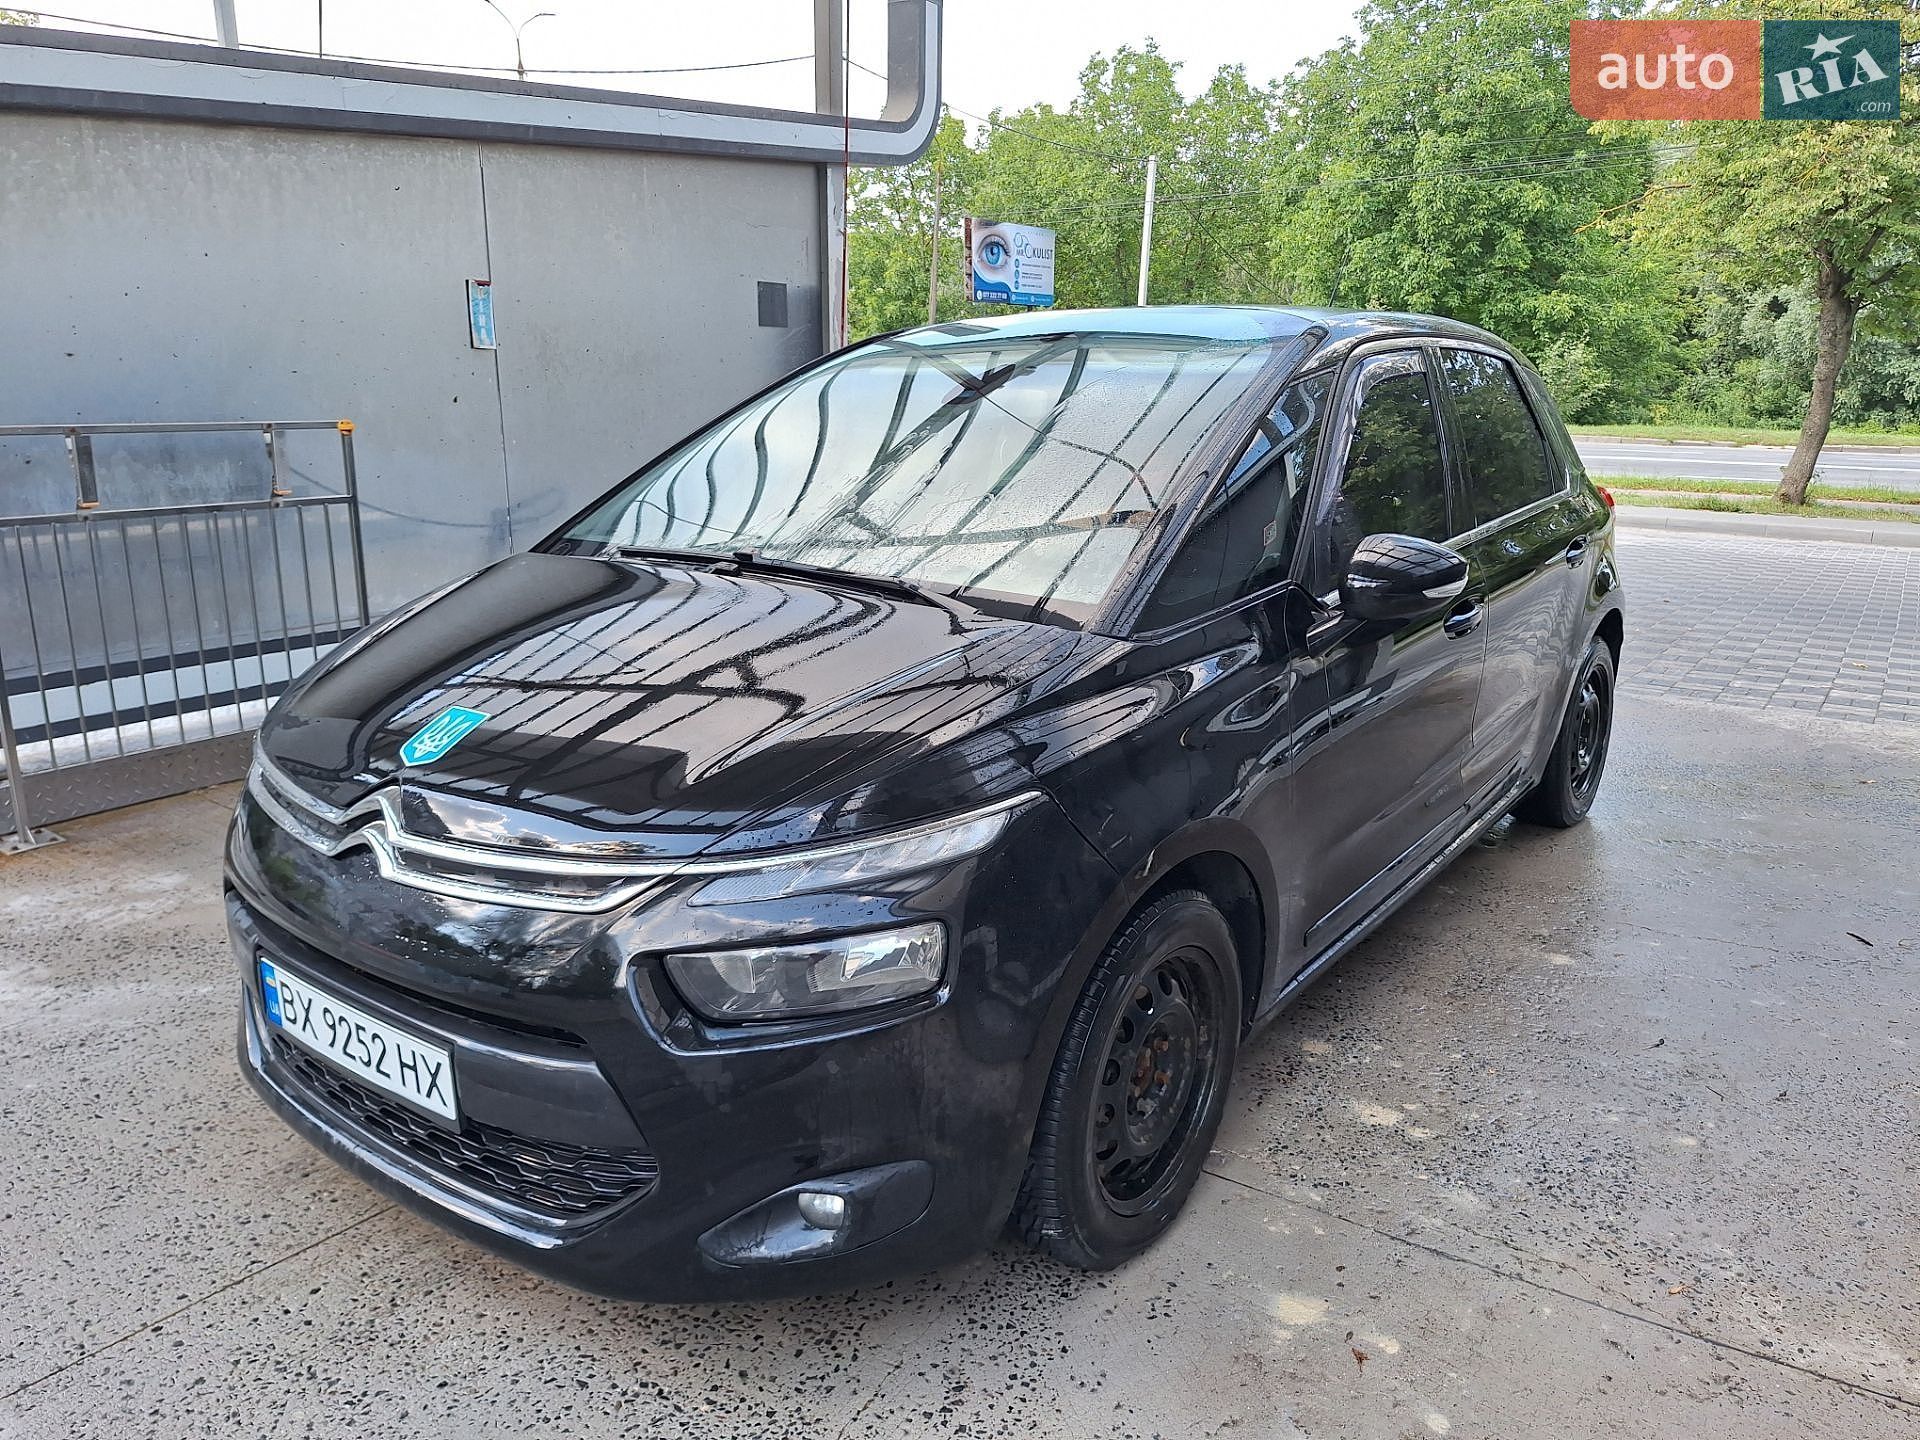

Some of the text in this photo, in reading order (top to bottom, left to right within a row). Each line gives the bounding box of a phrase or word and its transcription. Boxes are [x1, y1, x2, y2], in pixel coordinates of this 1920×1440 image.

[279, 980, 448, 1108] BX 9252 HX
